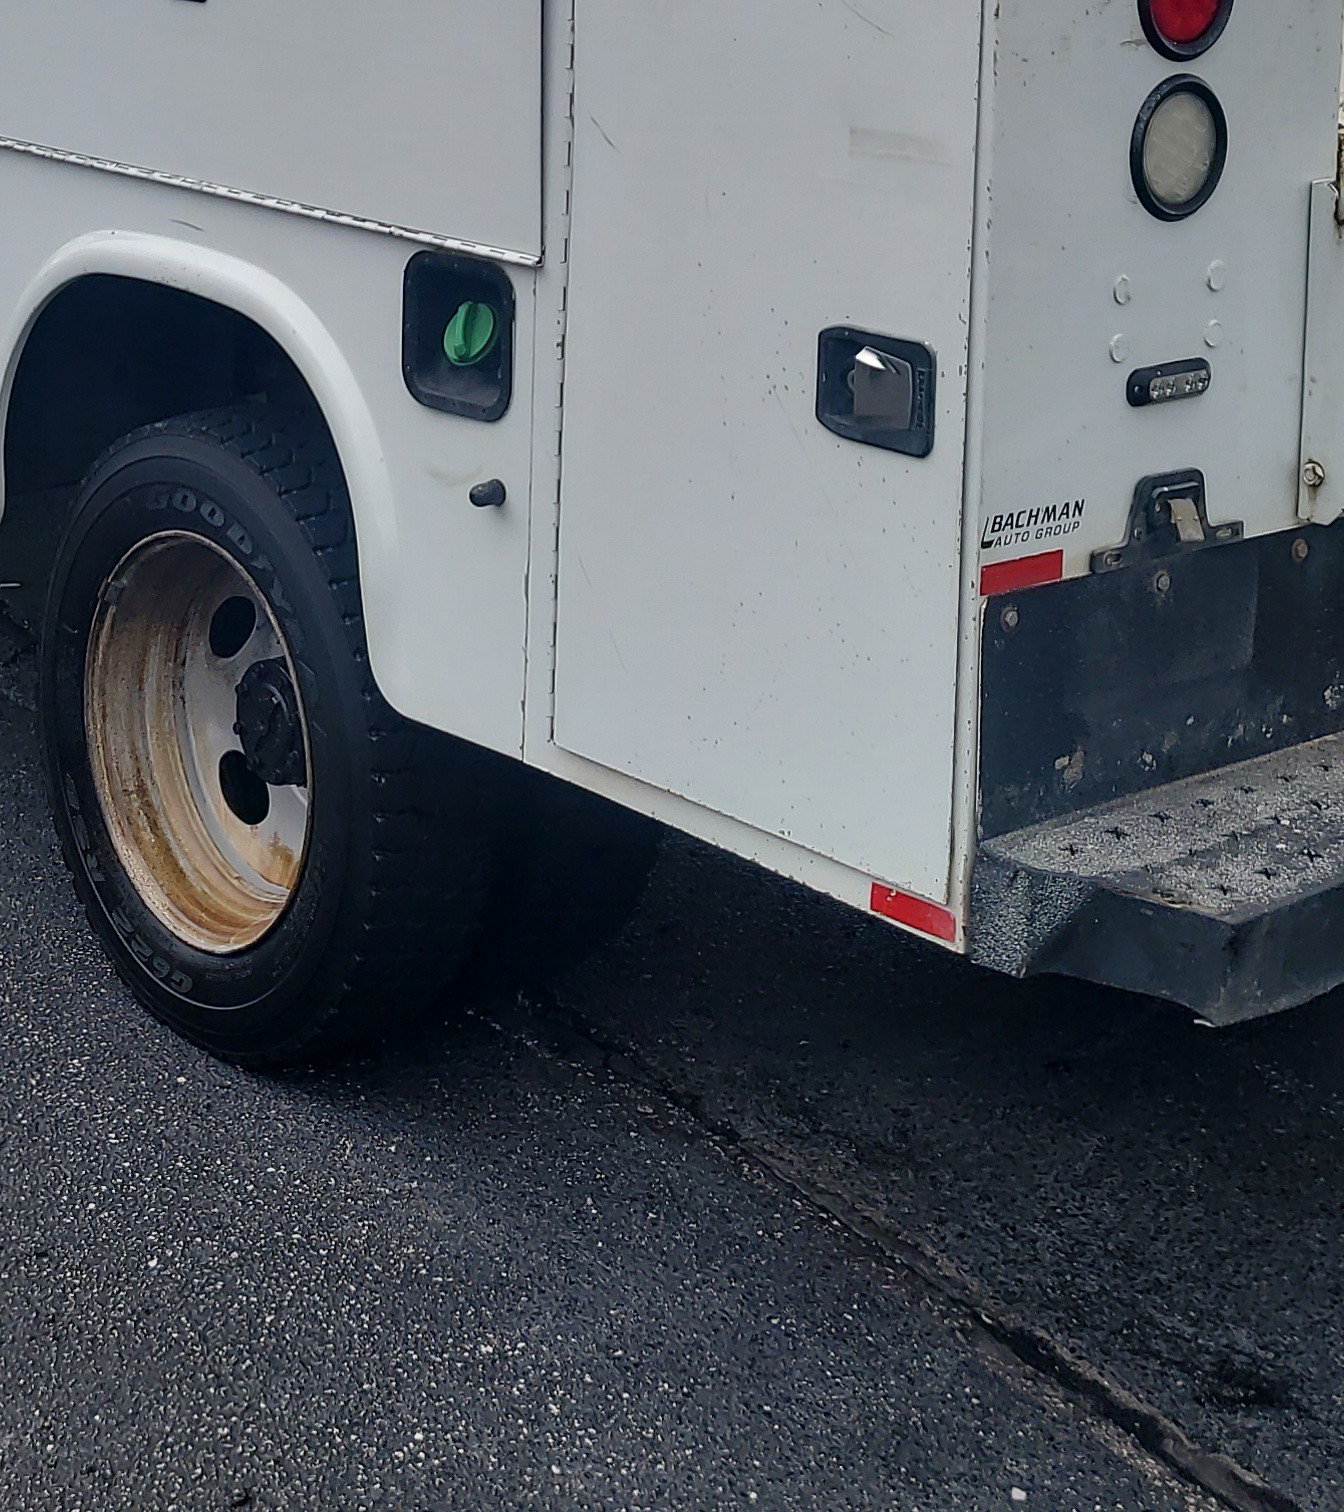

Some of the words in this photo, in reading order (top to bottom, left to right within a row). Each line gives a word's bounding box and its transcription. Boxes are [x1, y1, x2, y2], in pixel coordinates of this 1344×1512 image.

[990, 498, 1085, 534] BACHMAN
[993, 530, 1030, 549] AUTO
[1035, 520, 1081, 540] GROUP
